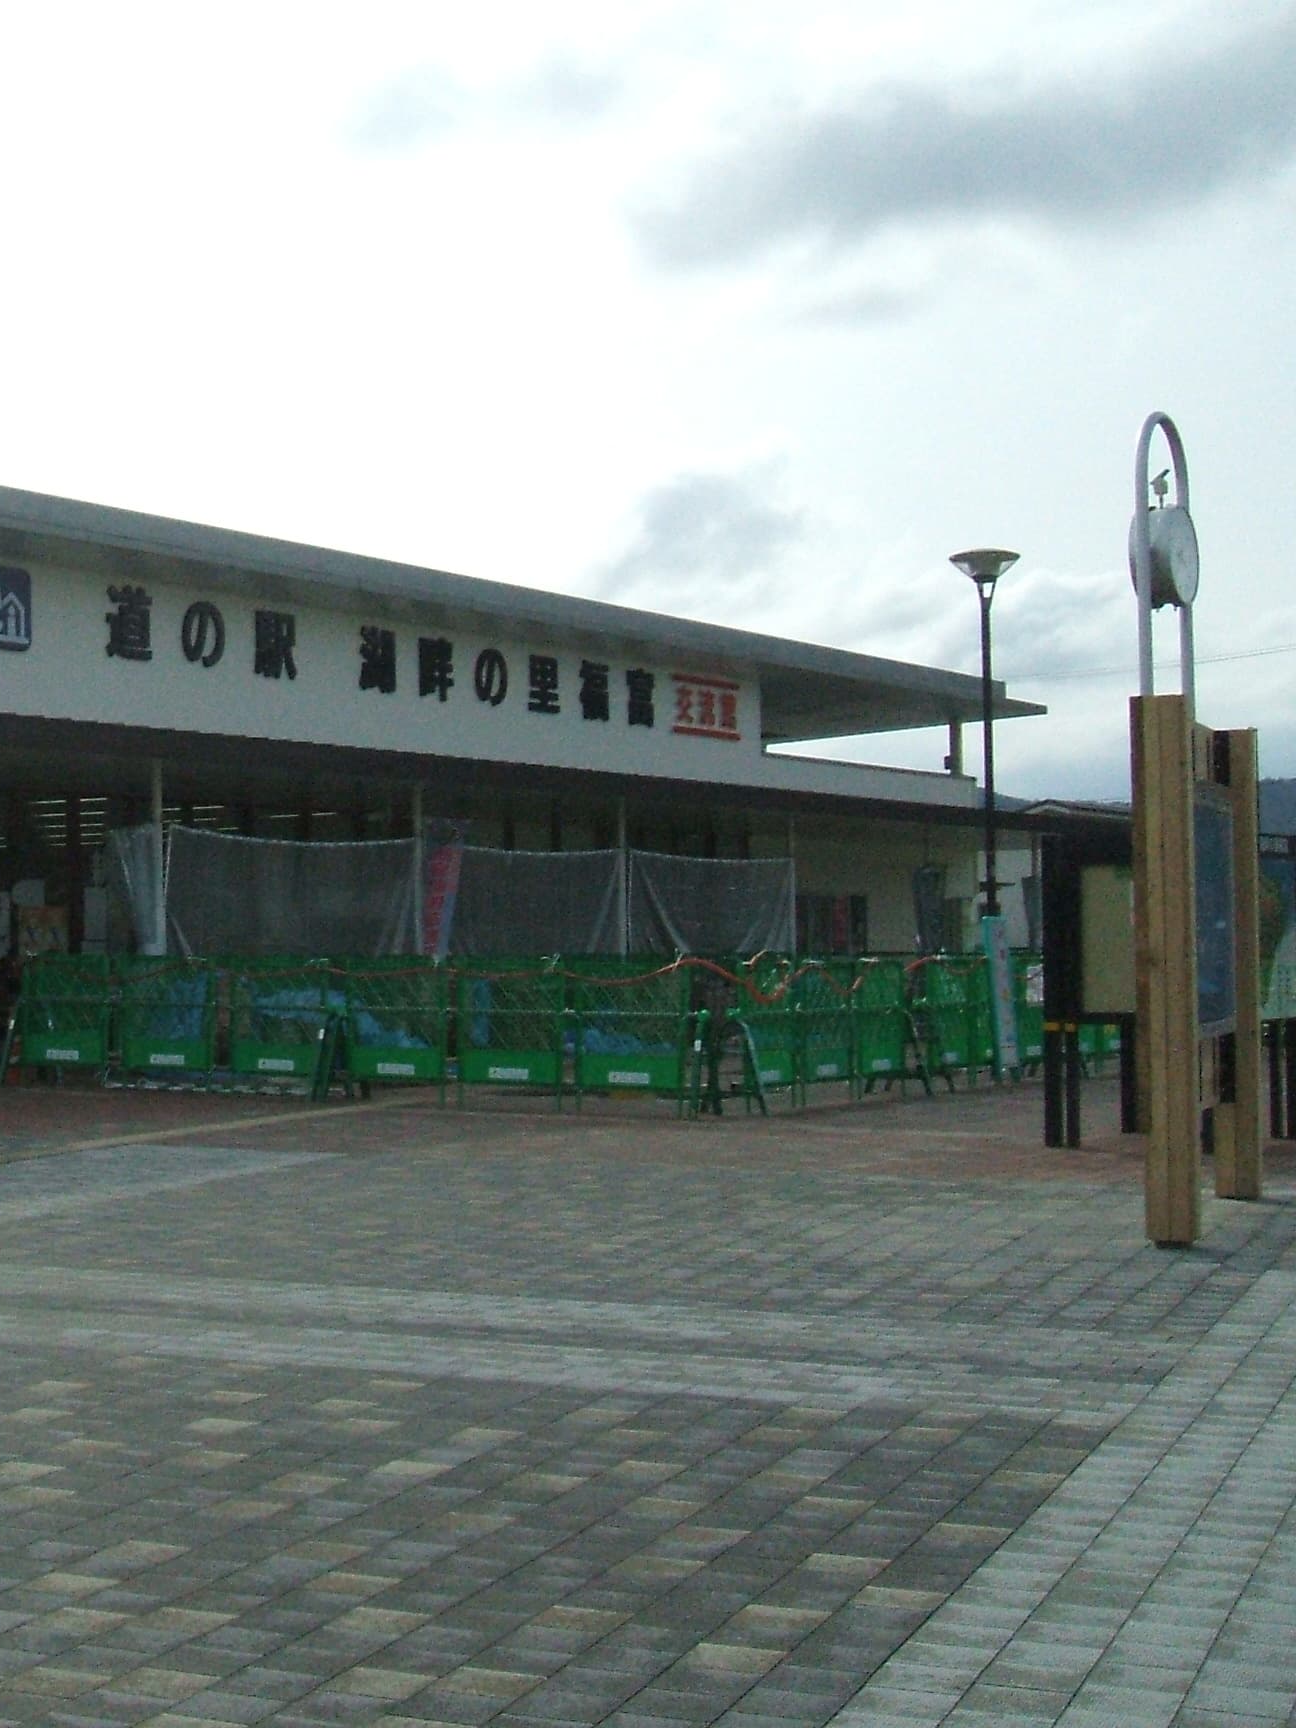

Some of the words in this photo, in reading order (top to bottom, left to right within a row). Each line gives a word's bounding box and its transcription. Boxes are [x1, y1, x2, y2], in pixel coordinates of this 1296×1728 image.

[106, 585, 297, 680] 道の駅
[359, 624, 655, 727] 湖畔の里福富
